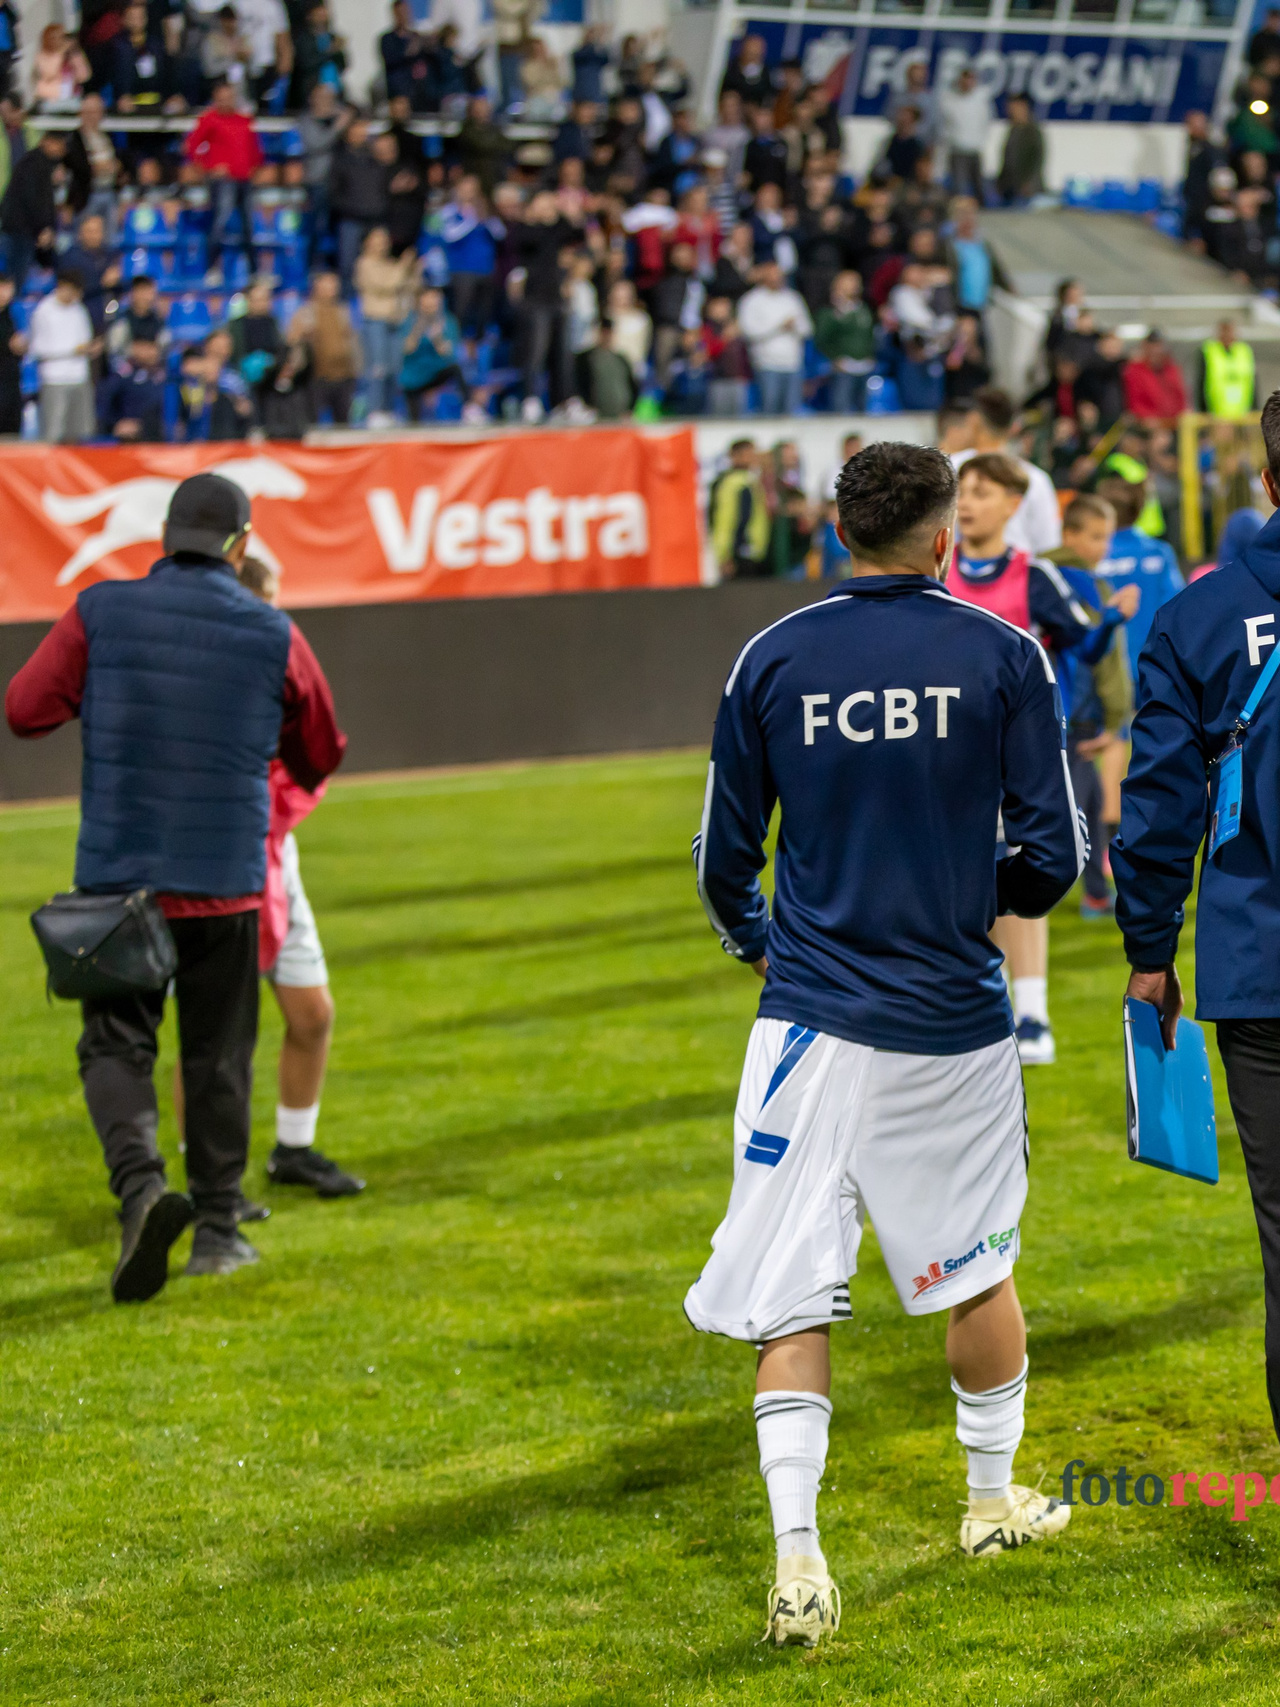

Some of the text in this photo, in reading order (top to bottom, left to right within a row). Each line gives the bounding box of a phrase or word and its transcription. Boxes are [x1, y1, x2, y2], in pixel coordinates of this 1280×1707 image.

[367, 486, 648, 573] Vestra
[801, 686, 961, 746] FCBT
[943, 1240, 986, 1274] Smart
